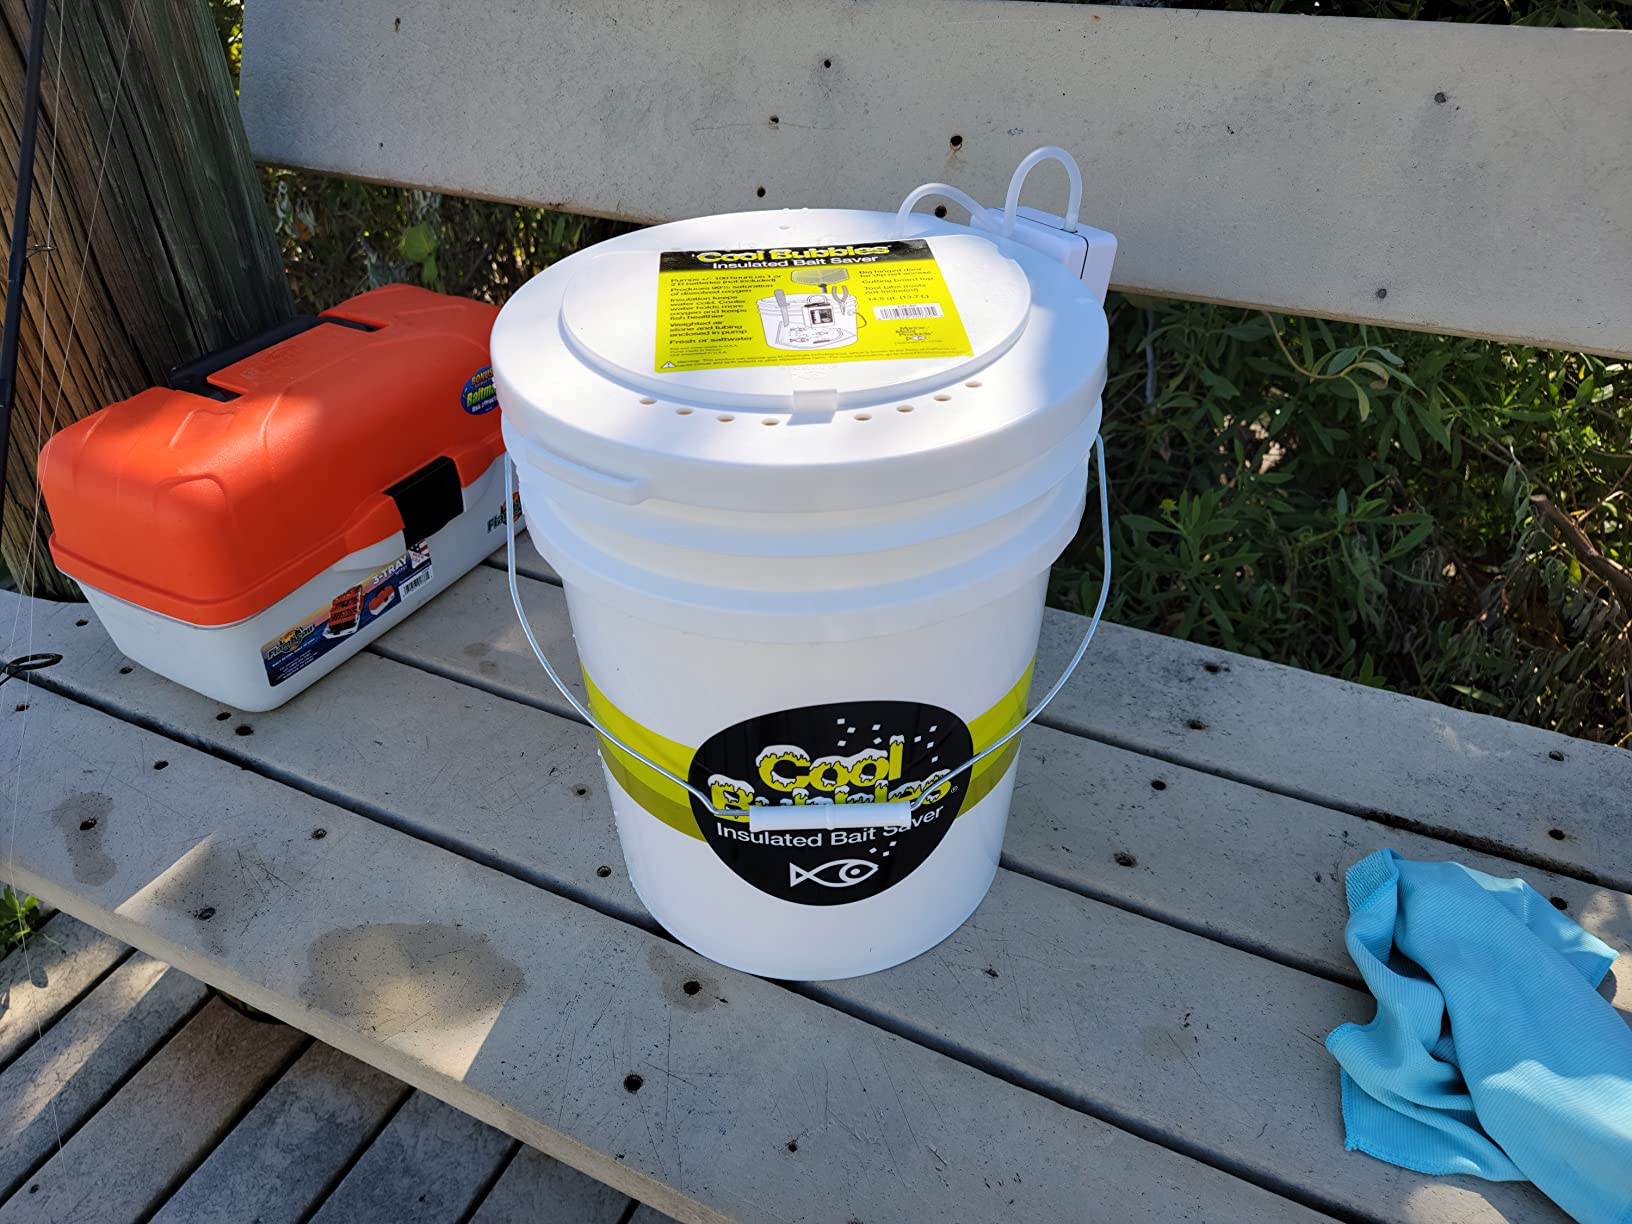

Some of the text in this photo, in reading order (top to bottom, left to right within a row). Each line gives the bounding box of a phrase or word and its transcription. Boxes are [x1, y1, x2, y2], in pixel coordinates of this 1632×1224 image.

[697, 246, 890, 263] Cool Bubbles
[713, 256, 879, 269] Insulated Bait Saver
[466, 384, 496, 407] Baitma
[372, 555, 407, 585] 3-TRAY
[756, 734, 904, 792] Cool
[717, 822, 822, 847] Insulated
[831, 826, 876, 846] Bait
